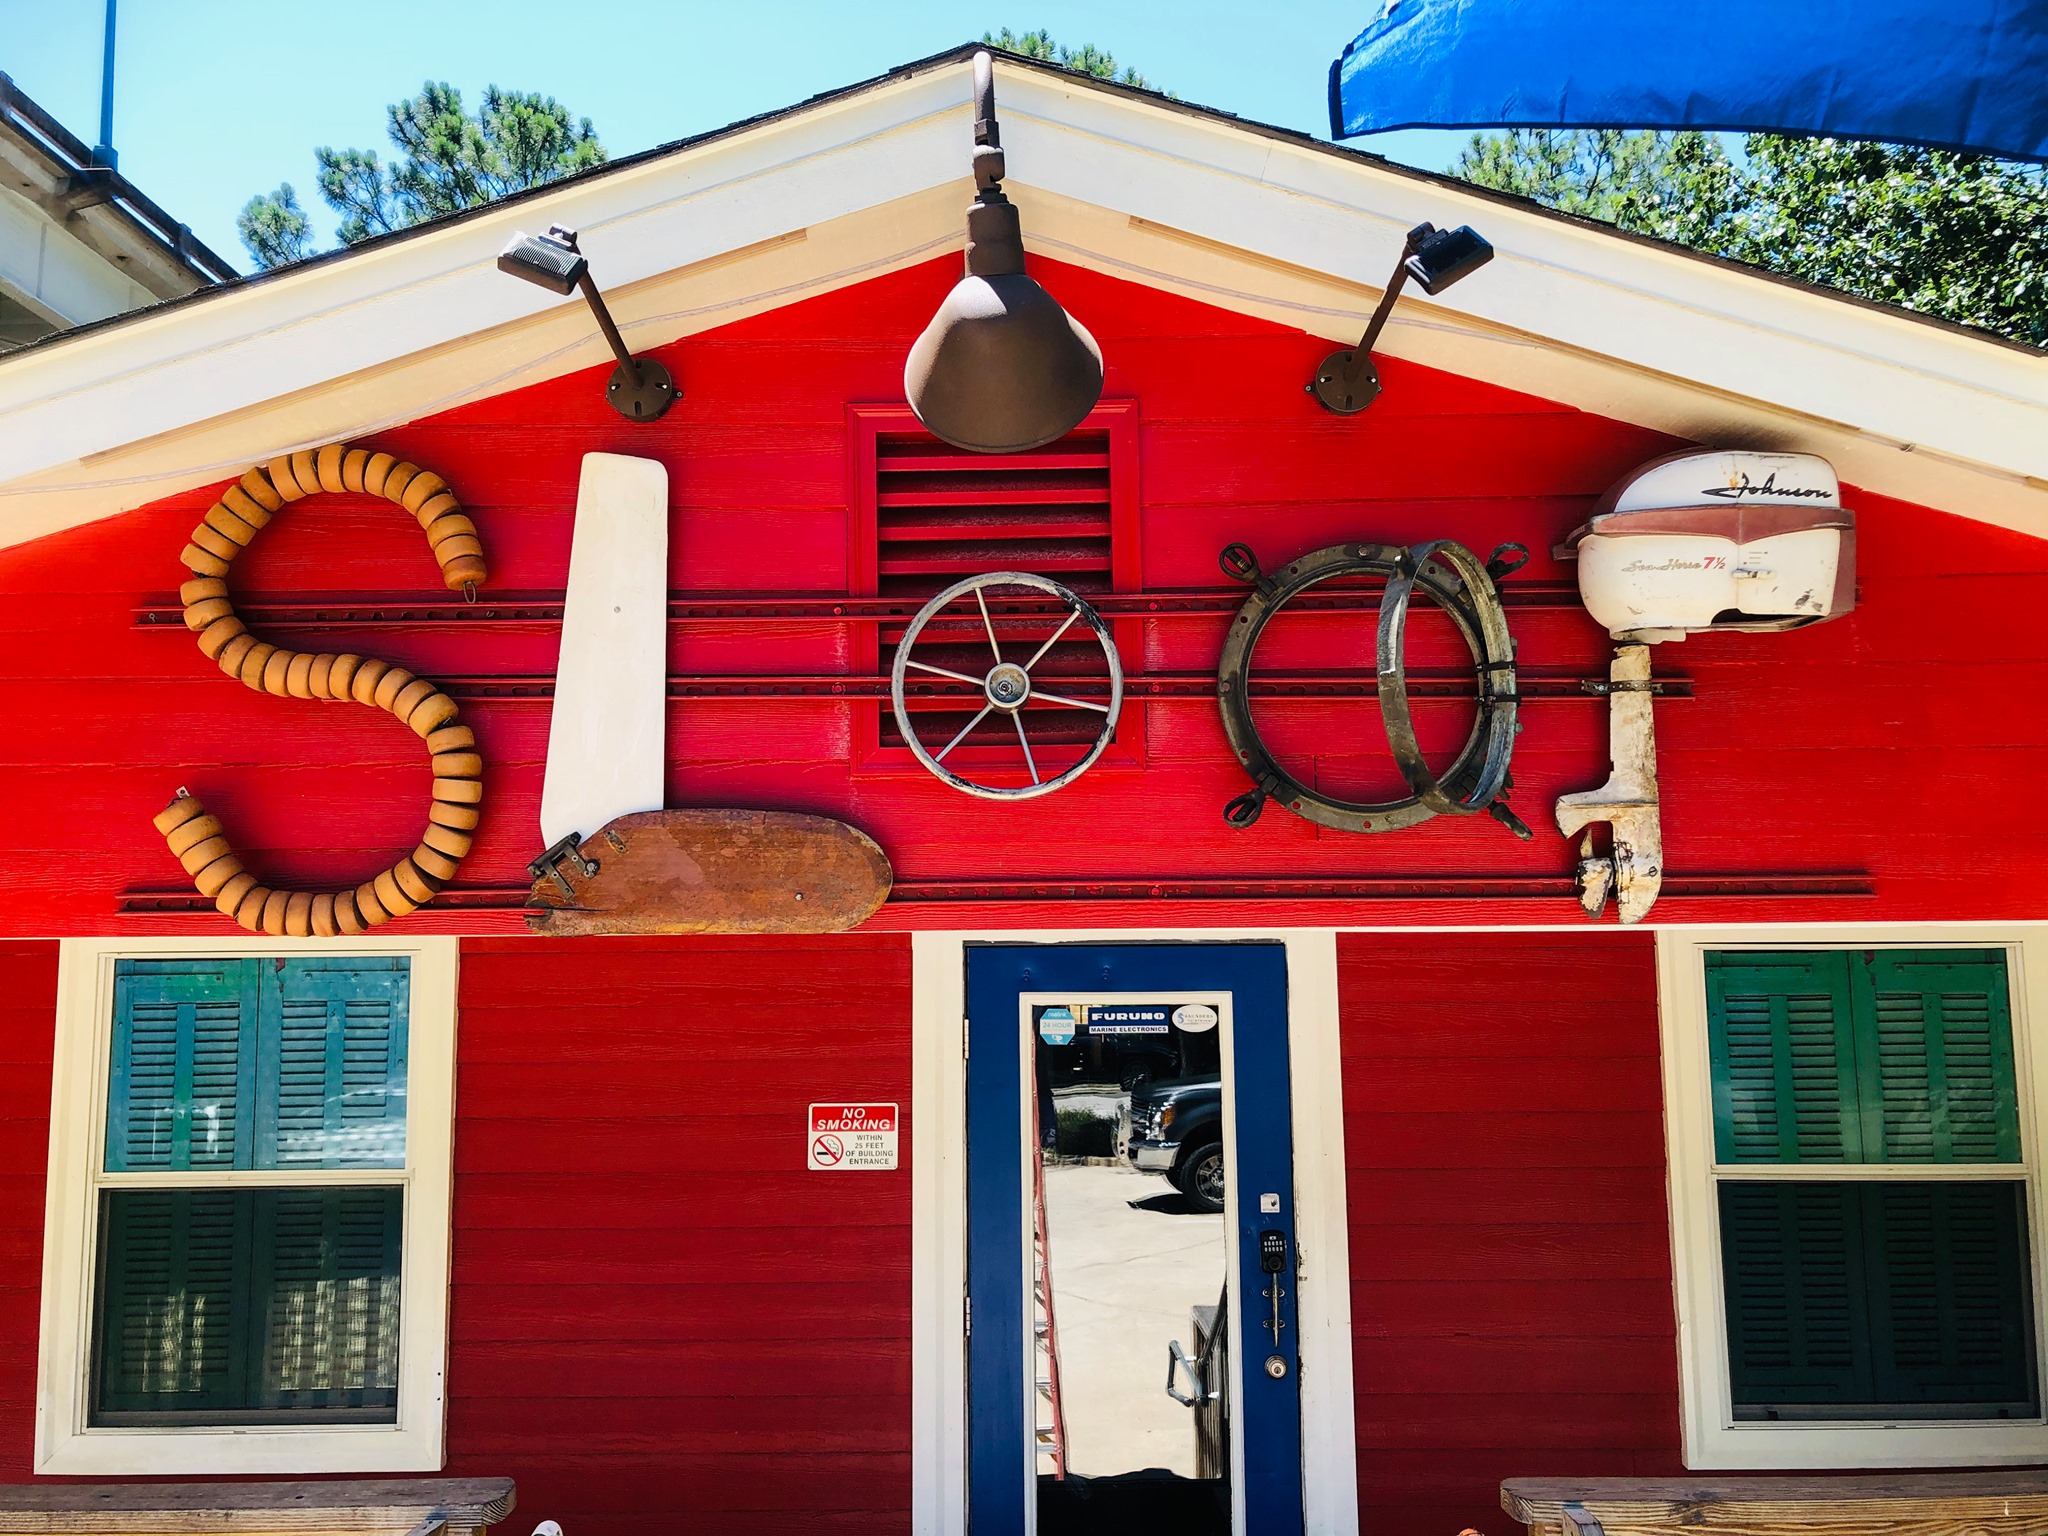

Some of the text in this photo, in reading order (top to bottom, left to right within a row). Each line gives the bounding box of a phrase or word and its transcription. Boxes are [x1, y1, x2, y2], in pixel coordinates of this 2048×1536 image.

[1701, 472, 1833, 499] Johnson
[1091, 1012, 1166, 1021] FURUNO
[842, 1108, 866, 1119] NO
[816, 1119, 891, 1131] SMOKING
